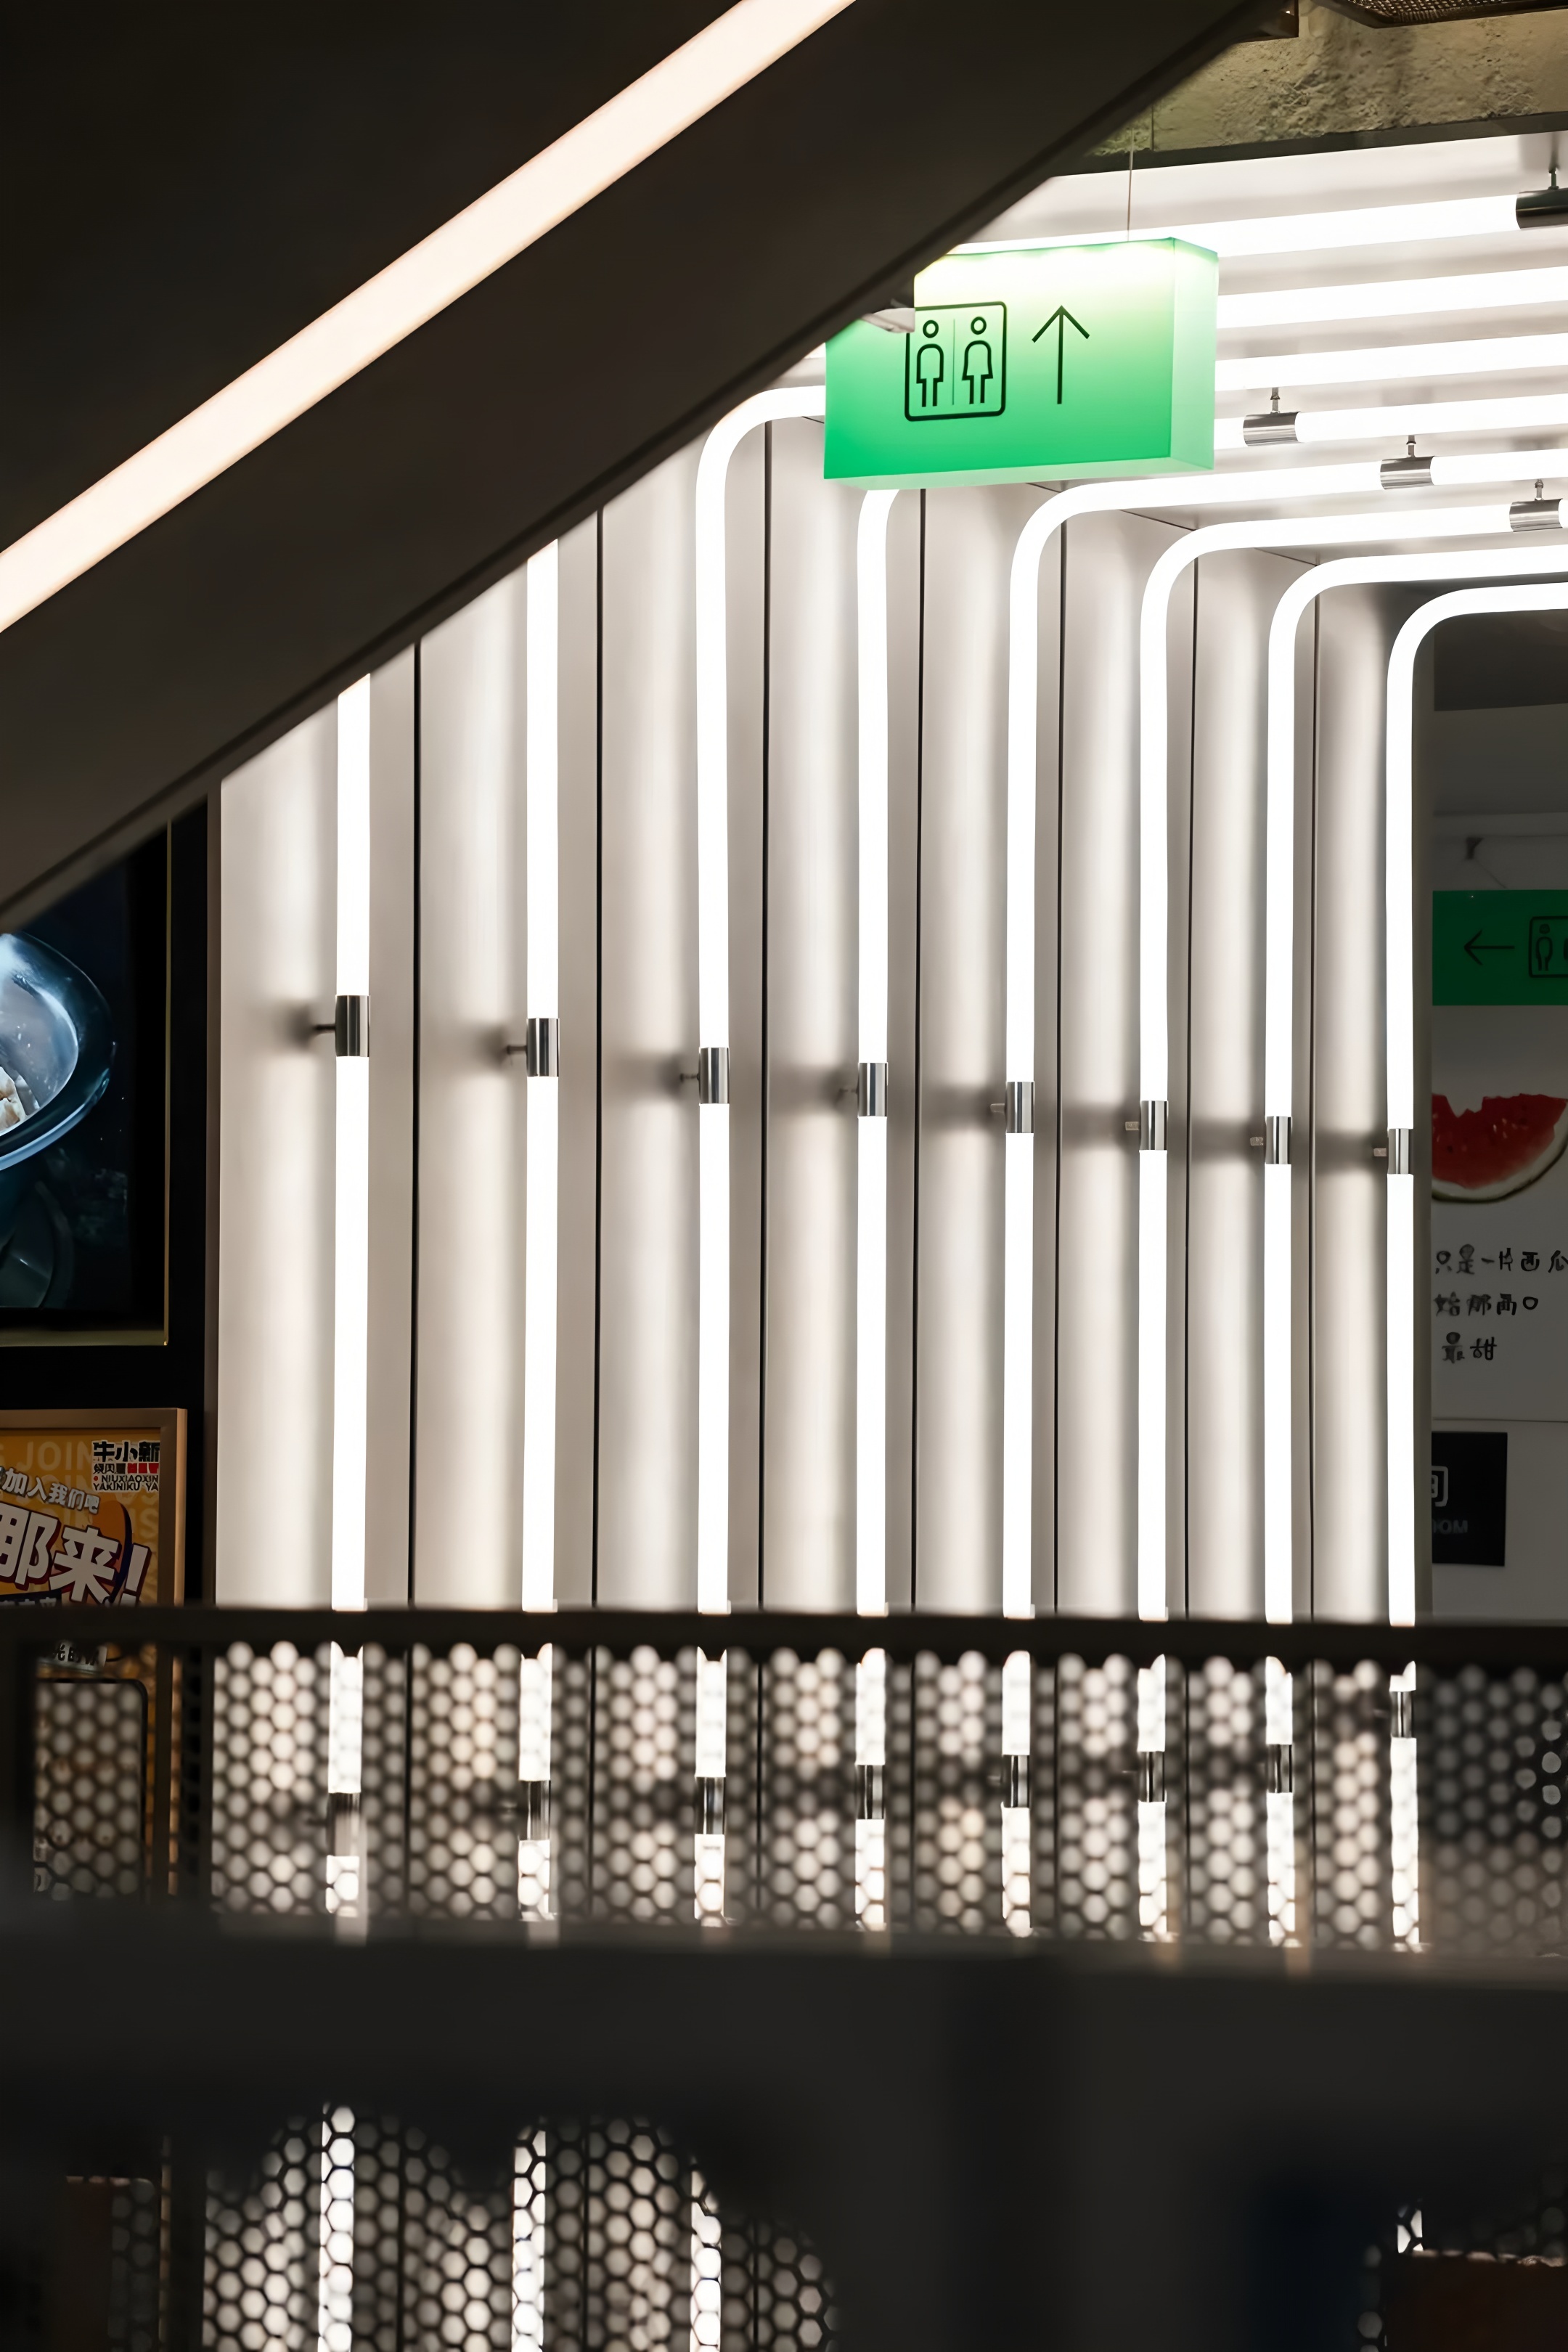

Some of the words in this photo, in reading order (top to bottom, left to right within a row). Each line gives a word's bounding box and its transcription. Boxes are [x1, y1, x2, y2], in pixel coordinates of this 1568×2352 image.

[1441, 1331, 1498, 1364] 最甜
[0, 1466, 101, 1514] 加入我们吧
